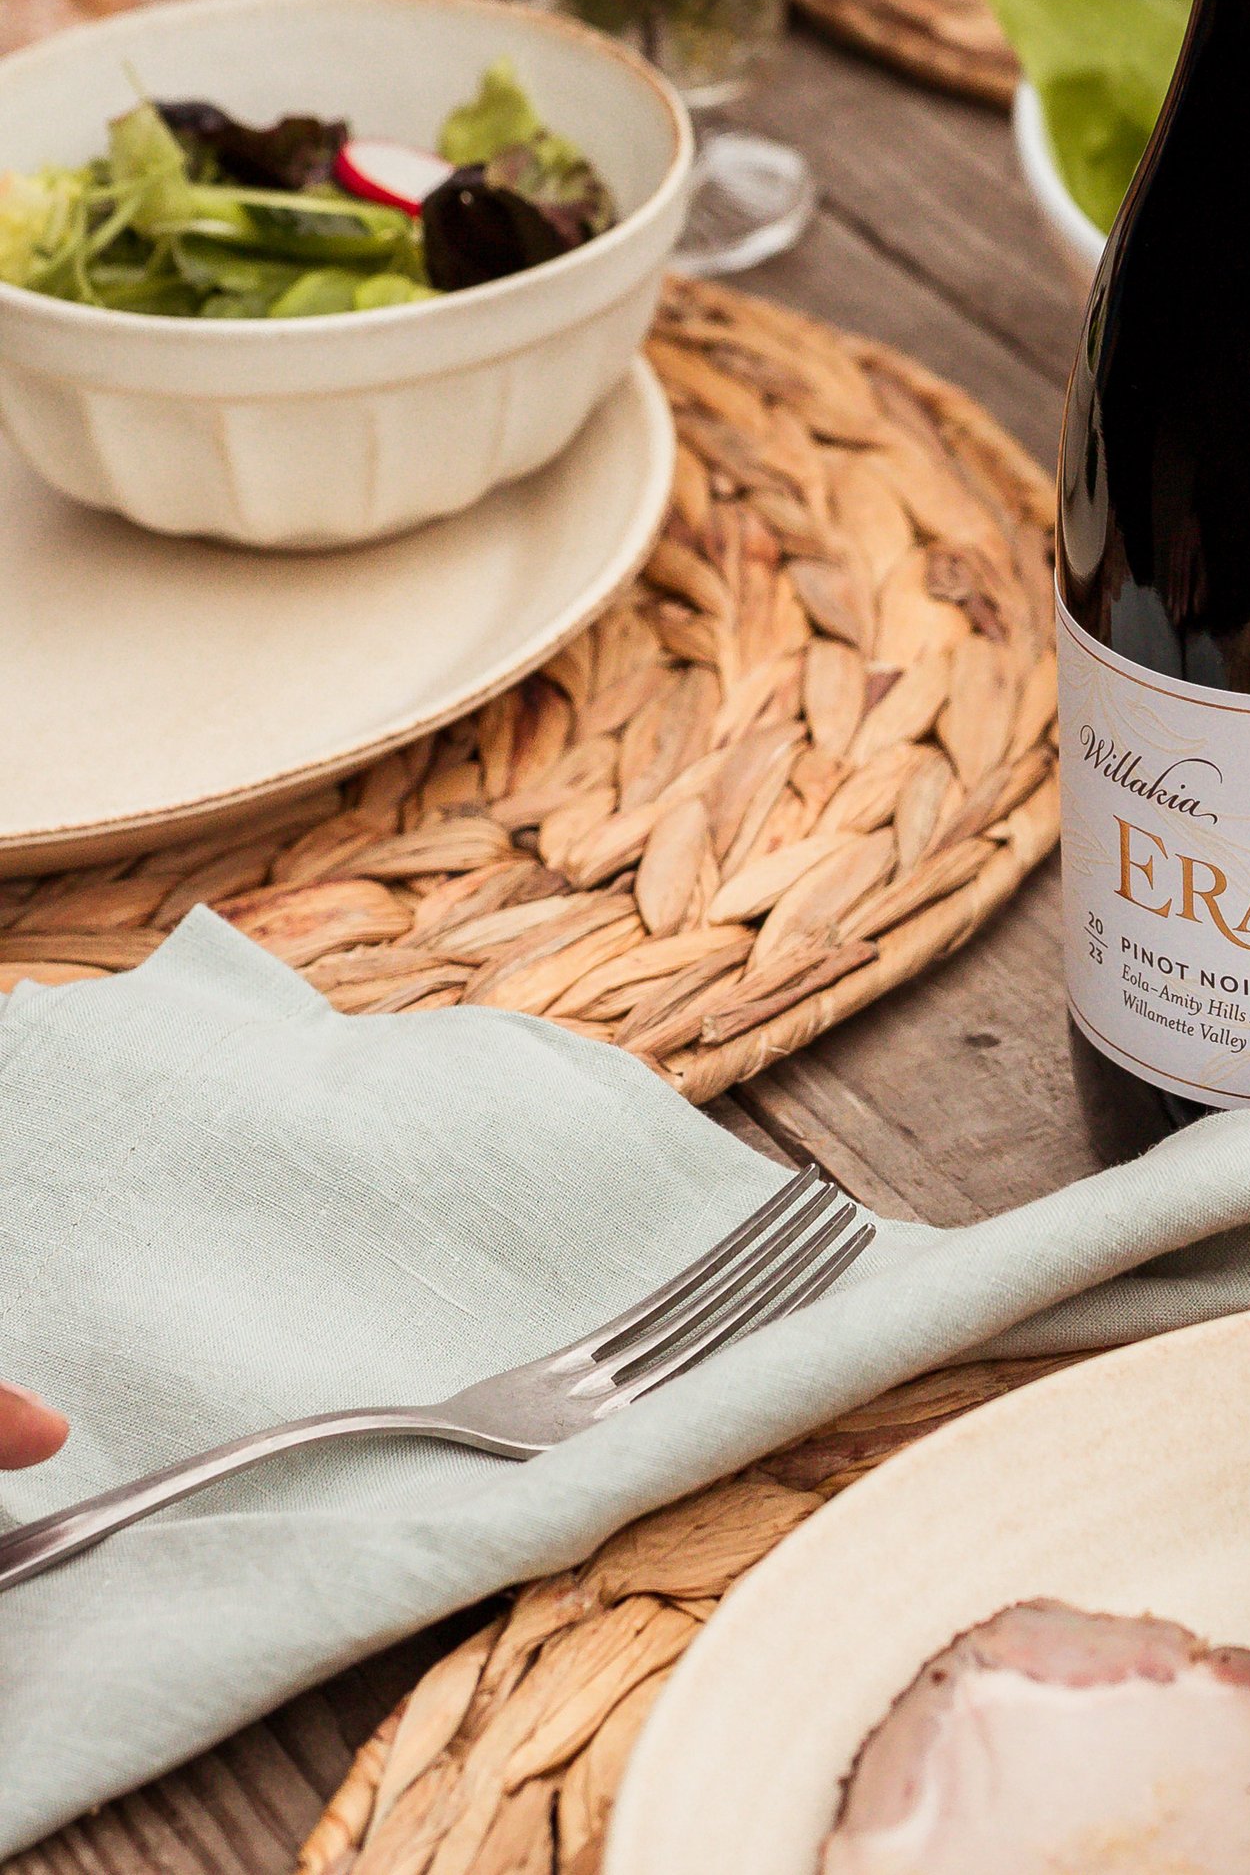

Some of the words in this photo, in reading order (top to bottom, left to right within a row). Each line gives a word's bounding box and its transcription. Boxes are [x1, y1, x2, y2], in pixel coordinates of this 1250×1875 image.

[1080, 724, 1223, 825] Willakia
[1087, 911, 1104, 935] 20
[1088, 941, 1104, 965] 23
[1121, 935, 1190, 980] PINOT
[1121, 963, 1203, 1016] Eola-Amity
[1207, 998, 1246, 1022] Hills
[1122, 989, 1195, 1036] Willamette
[1200, 1023, 1247, 1054] Valley
